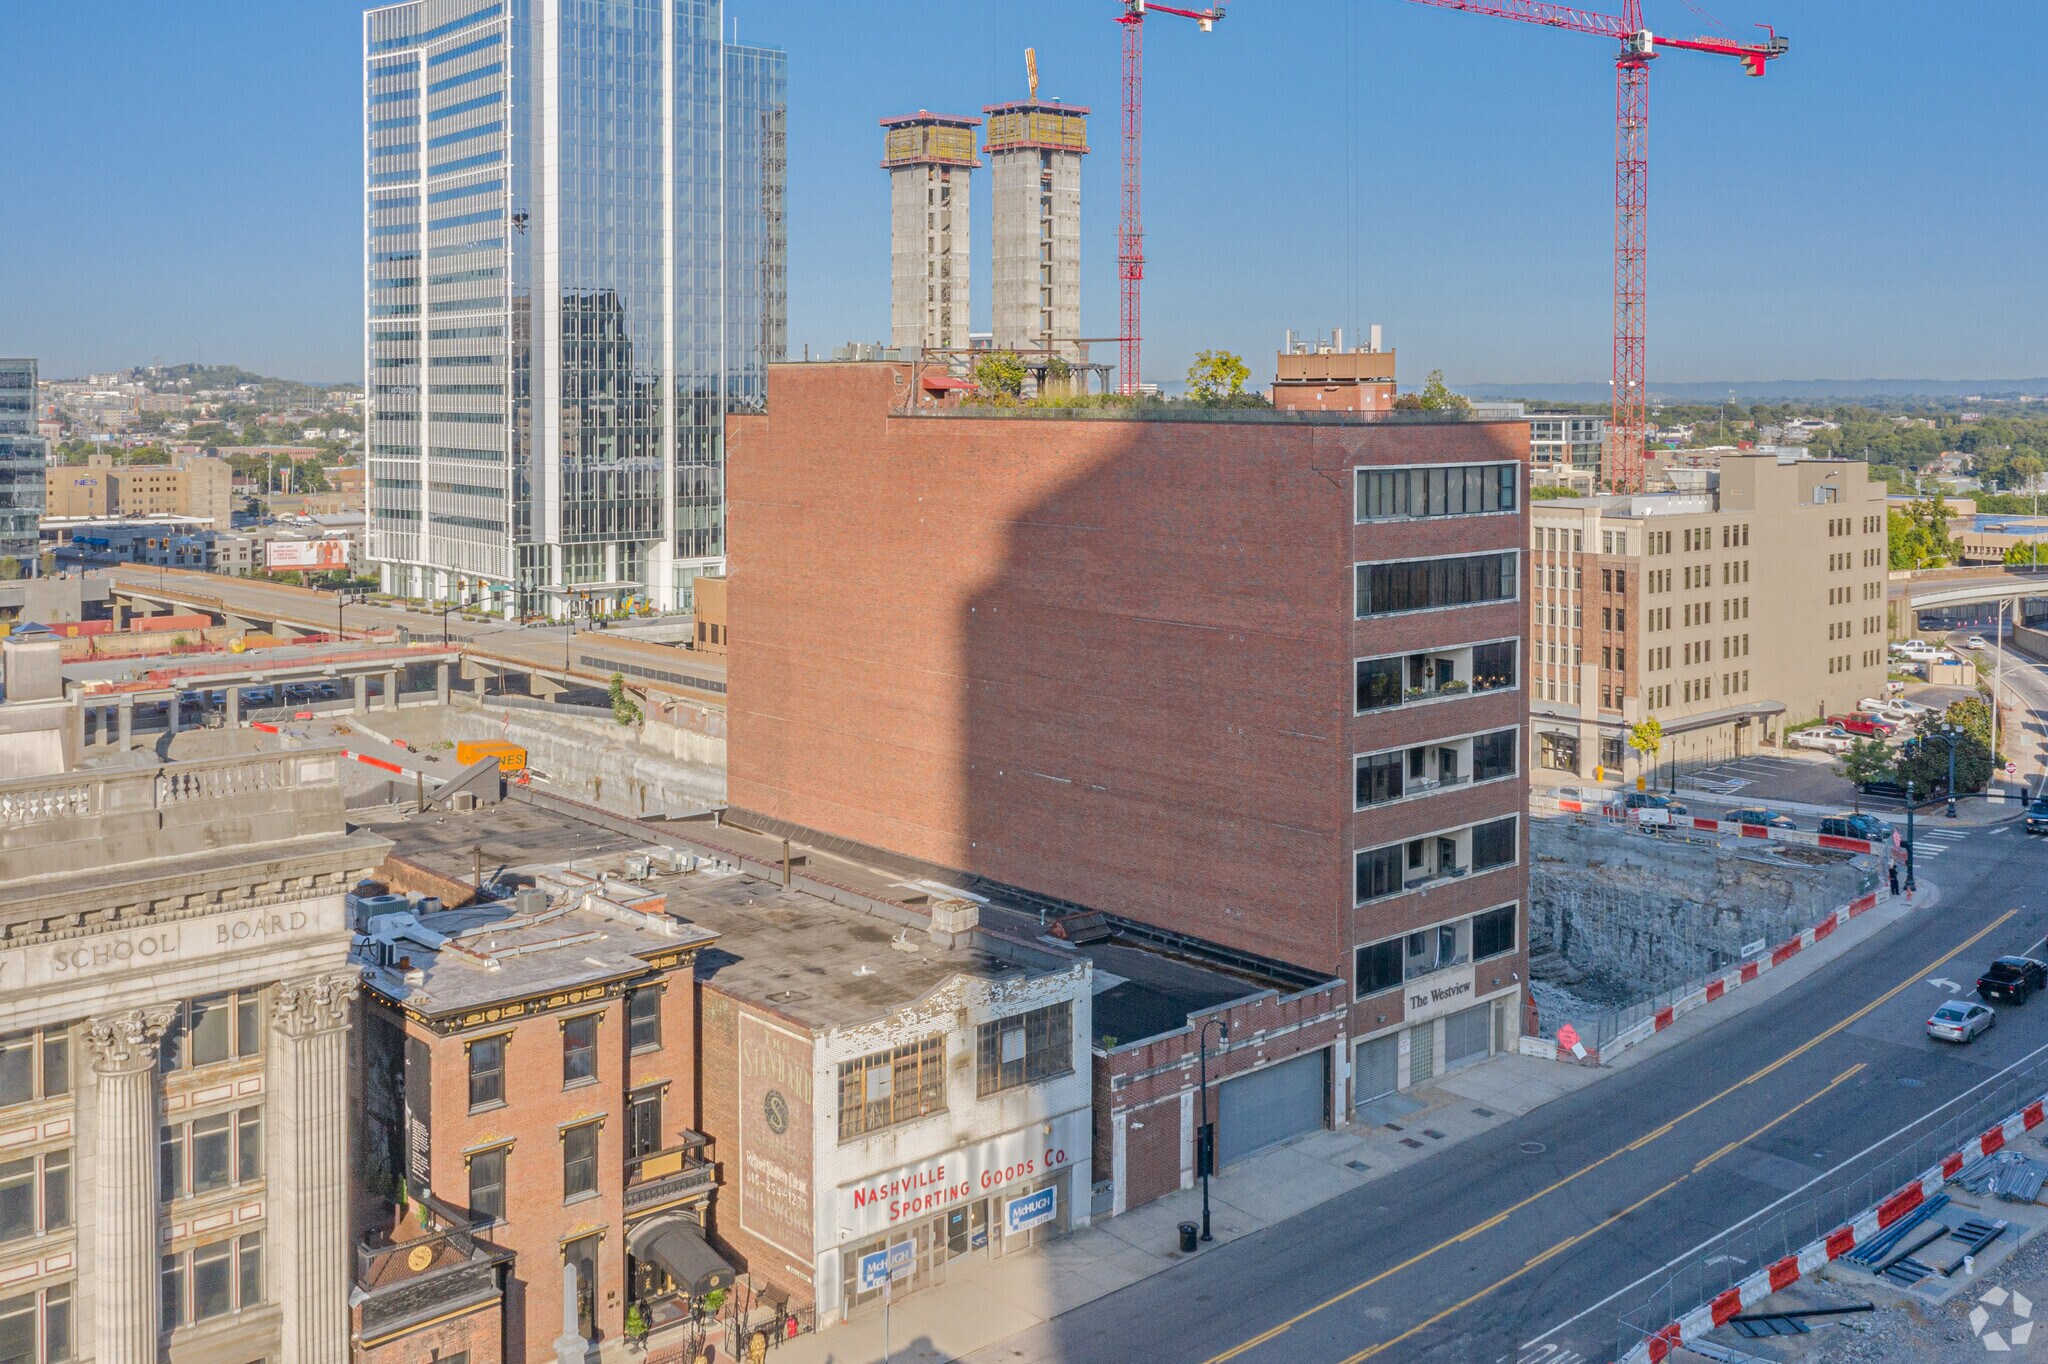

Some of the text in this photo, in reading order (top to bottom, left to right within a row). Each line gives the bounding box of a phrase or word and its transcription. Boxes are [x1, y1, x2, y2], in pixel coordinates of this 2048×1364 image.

[55, 911, 308, 972] SCHOOL BOARD
[1409, 981, 1471, 1010] The Westview
[764, 1030, 790, 1054] THE
[743, 1039, 812, 1105] STANDARD
[854, 1165, 945, 1210] NASHVILLE
[889, 1181, 970, 1221] SPORTING
[980, 1159, 1034, 1189] GOODS
[1012, 1196, 1050, 1219] McHUGH
